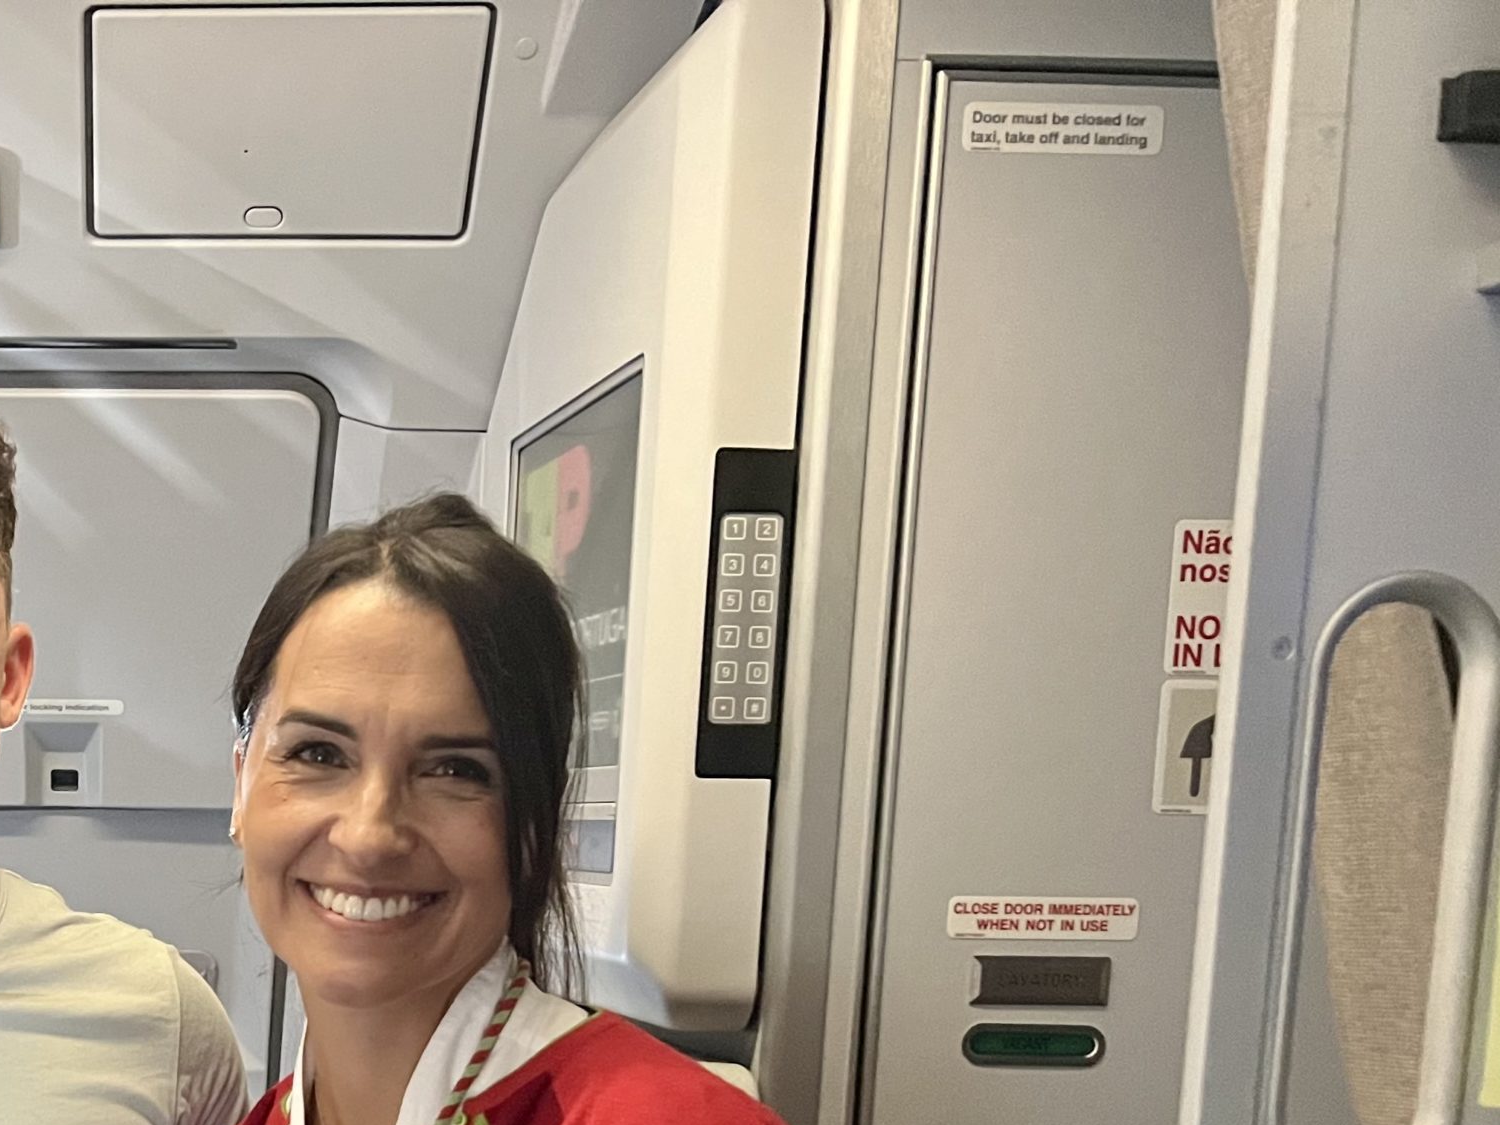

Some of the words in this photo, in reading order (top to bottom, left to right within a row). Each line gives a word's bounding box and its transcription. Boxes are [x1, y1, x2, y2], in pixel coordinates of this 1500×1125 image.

[972, 110, 1008, 124] Door
[1012, 113, 1048, 125] must
[1051, 113, 1070, 125] be
[1073, 113, 1122, 126] closed
[1125, 114, 1147, 127] for
[970, 130, 1001, 145] taxi,
[1005, 131, 1035, 144] take
[1039, 131, 1059, 144] off
[1062, 132, 1090, 145] and
[1094, 132, 1148, 149] landing
[732, 523, 739, 534] 1
[762, 523, 772, 535] 2
[728, 559, 738, 571] 3
[760, 560, 768, 570] 4
[726, 594, 736, 606] 5
[758, 595, 766, 607] 6
[724, 631, 733, 642] 7
[1173, 643, 1202, 667] IN
[722, 667, 730, 678] 9
[753, 667, 762, 678] 0
[954, 903, 999, 914] CLOSE
[1004, 903, 1044, 915] DOOR
[1048, 904, 1136, 916] IMMEDIATELY
[977, 919, 1019, 931] WHEN
[1025, 920, 1055, 931] NOT
[1061, 920, 1075, 931] IN
[1080, 920, 1108, 932] USE
